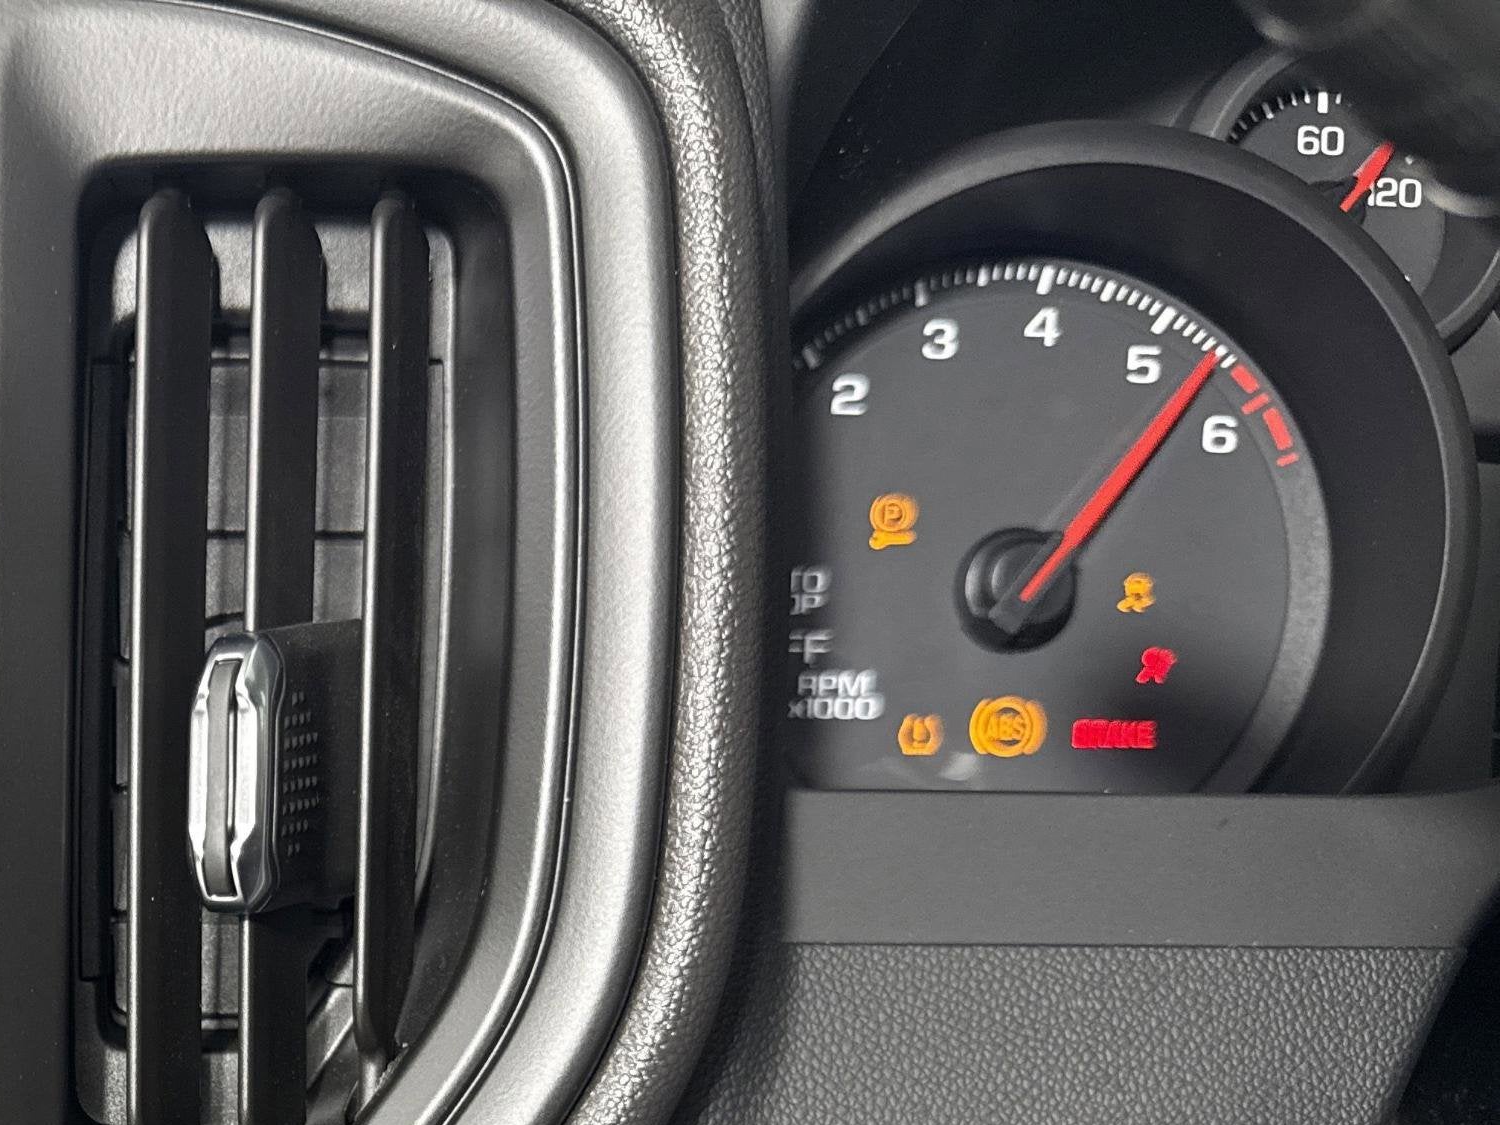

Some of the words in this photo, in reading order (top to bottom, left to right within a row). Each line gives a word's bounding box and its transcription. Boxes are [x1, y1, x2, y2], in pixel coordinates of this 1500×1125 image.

[1297, 125, 1344, 155] 60
[1367, 178, 1422, 207] 120
[922, 318, 960, 360] 3
[1024, 307, 1061, 347] 4
[1126, 345, 1162, 384] 5
[830, 374, 870, 415] 2
[1201, 415, 1239, 454] 6
